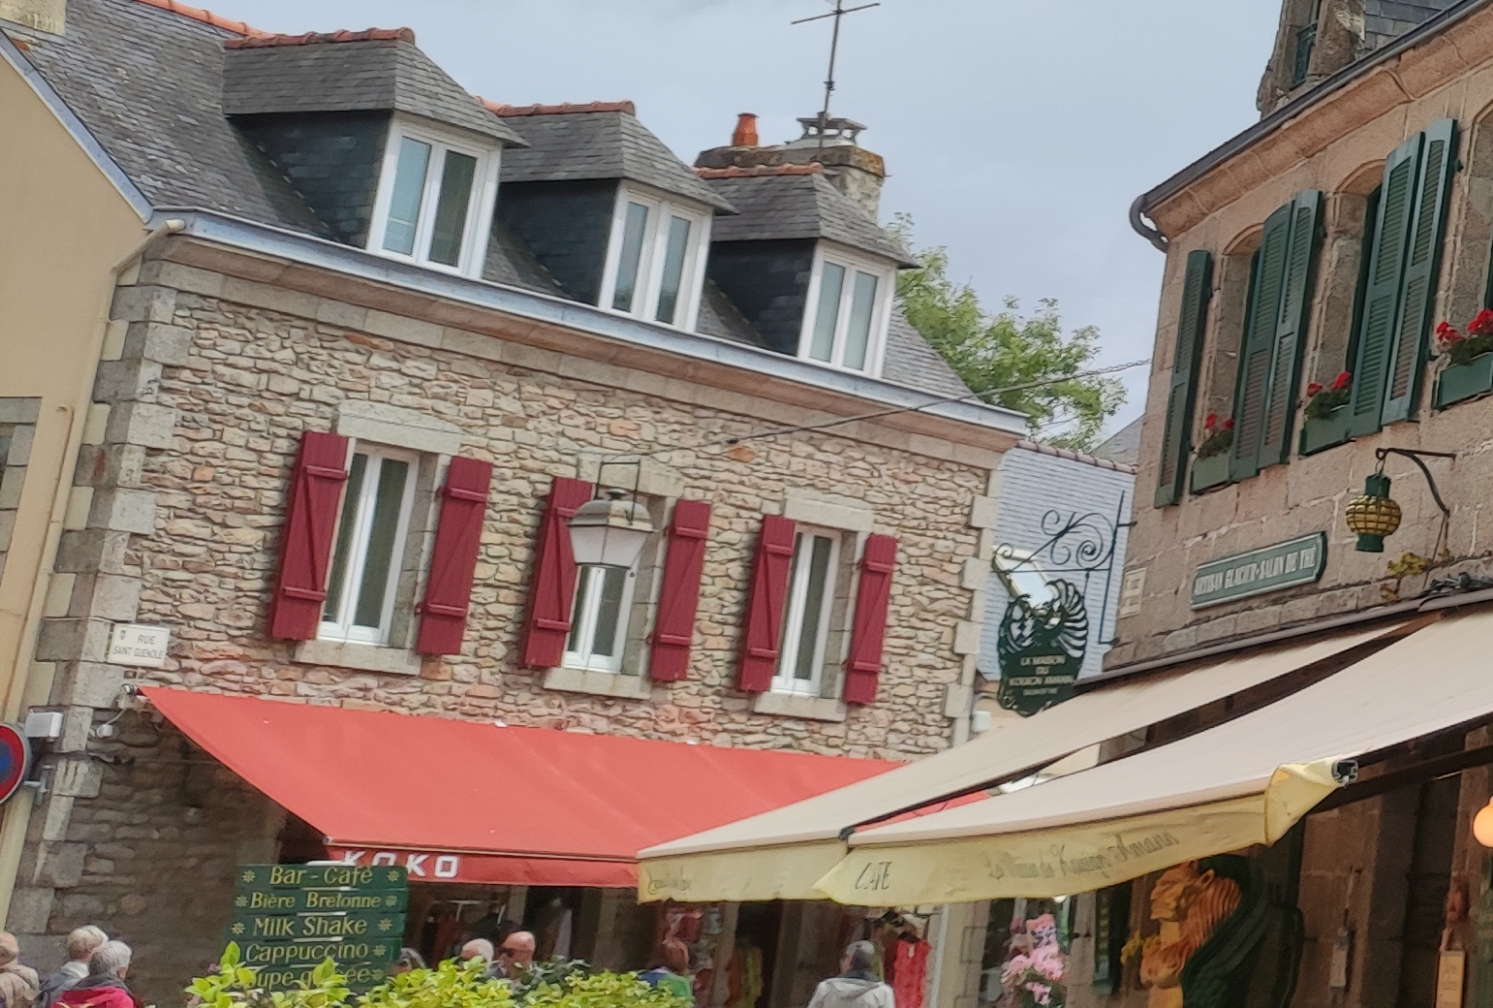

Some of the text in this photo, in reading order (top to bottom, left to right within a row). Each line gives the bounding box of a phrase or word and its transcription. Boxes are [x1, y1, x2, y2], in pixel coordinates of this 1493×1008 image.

[137, 634, 156, 645] RUE
[112, 645, 133, 656] SAINT
[269, 867, 308, 885] Bar
[323, 866, 374, 885] Café
[250, 892, 381, 910] Bière Bretonne
[253, 916, 368, 937] Milk Shake
[245, 943, 369, 964] Cappuccino
